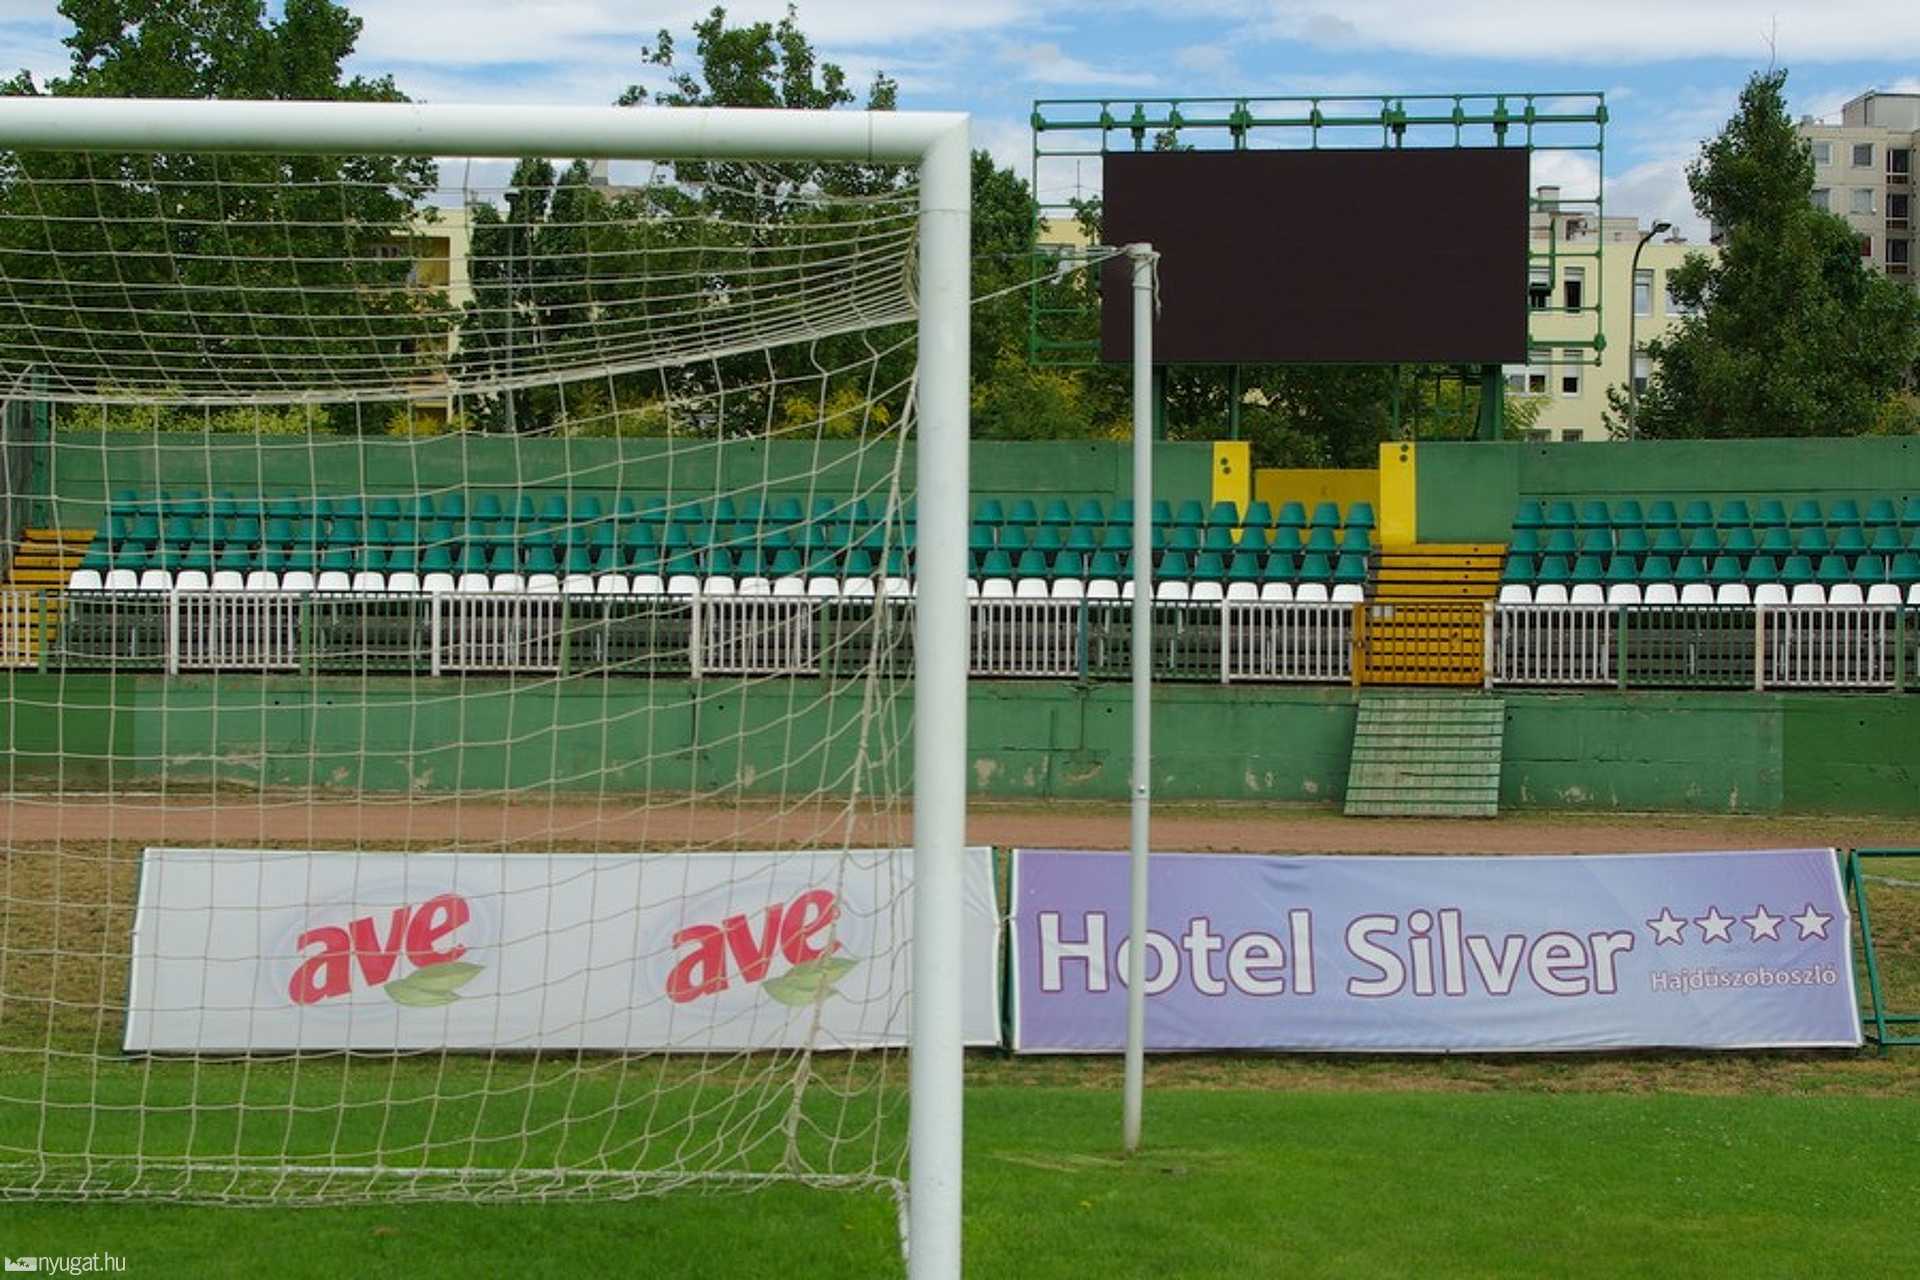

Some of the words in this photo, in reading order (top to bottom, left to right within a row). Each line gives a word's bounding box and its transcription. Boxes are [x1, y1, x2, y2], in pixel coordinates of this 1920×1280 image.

[288, 893, 470, 1005] ave
[665, 888, 842, 1004] ave
[1037, 909, 1316, 997] Hotel
[1344, 908, 1634, 997] Silver
